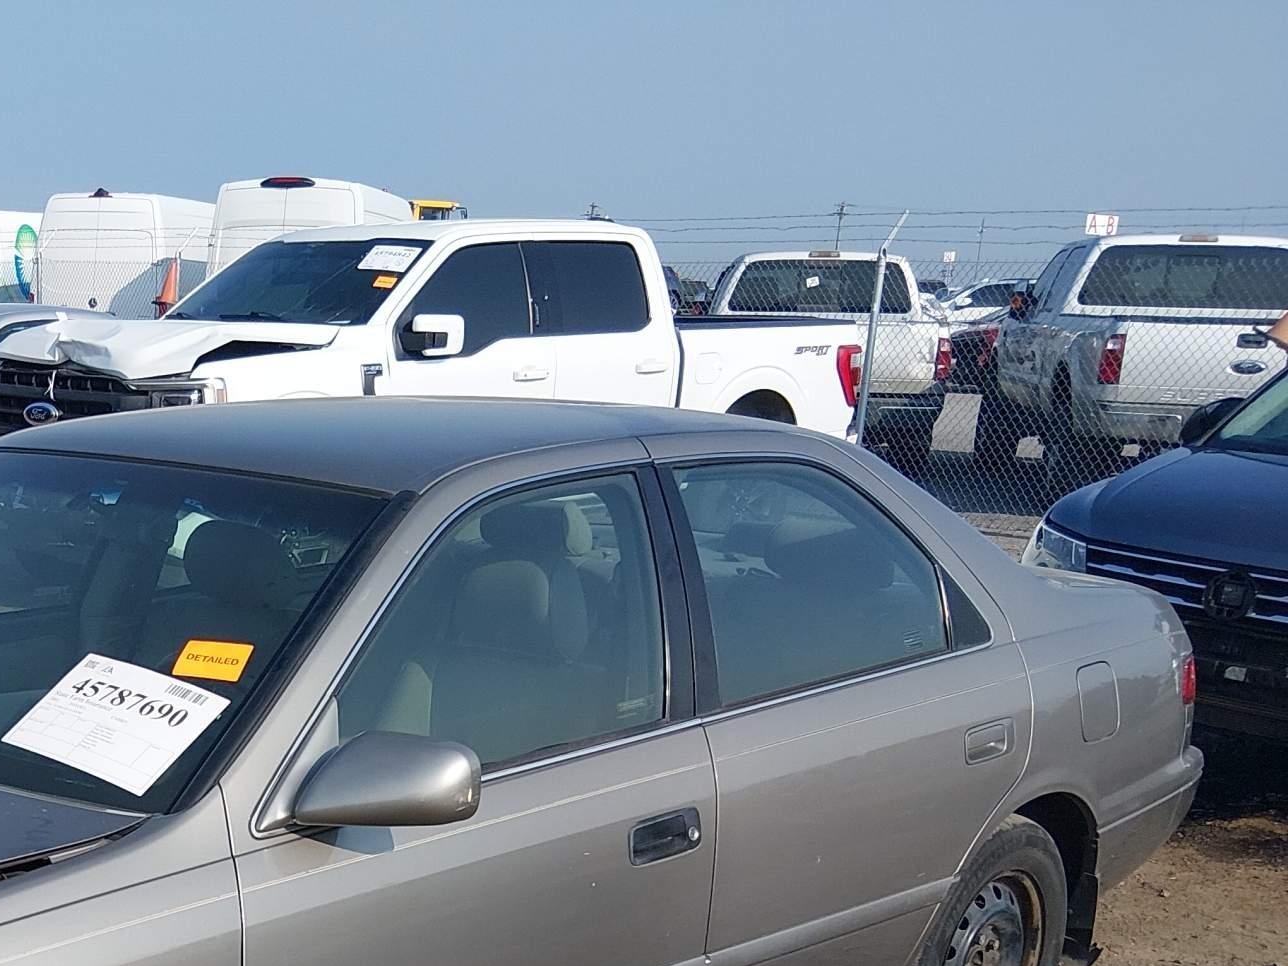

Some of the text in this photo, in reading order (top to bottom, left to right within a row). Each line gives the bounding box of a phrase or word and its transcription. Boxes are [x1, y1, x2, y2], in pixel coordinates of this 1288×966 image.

[793, 344, 832, 356] SPORT
[186, 653, 239, 666] DETAILED
[71, 677, 189, 728] 45787690
